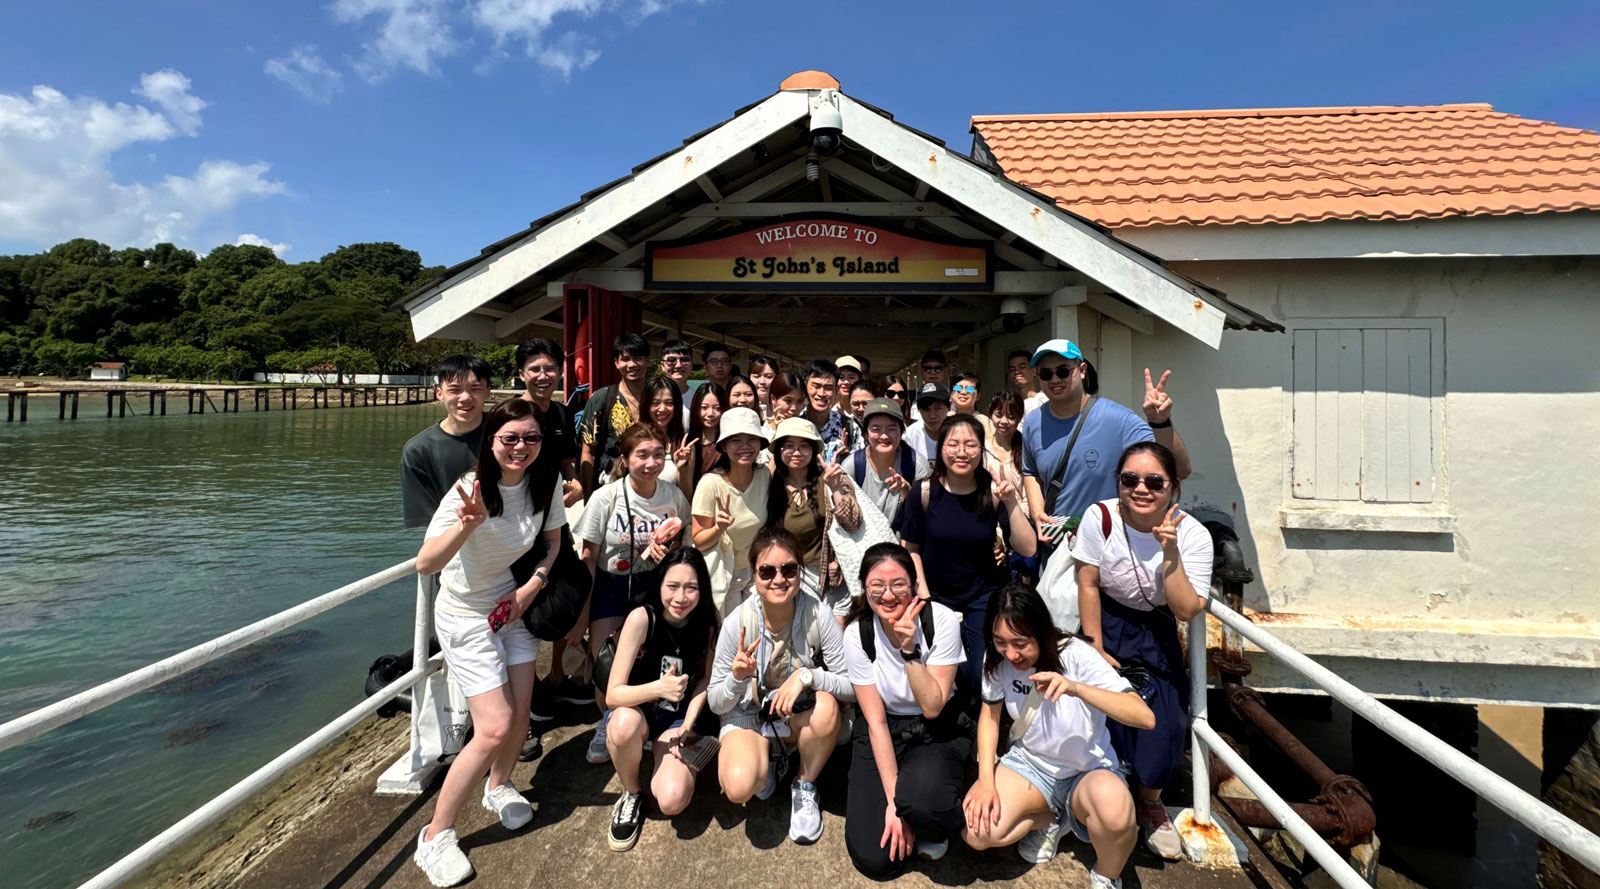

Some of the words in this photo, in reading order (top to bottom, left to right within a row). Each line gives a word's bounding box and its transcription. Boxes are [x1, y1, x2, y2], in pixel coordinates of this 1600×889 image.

[756, 223, 848, 245] WELCOME
[854, 228, 878, 245] TO
[732, 257, 756, 277] St
[761, 257, 825, 278] John's
[832, 257, 899, 276] Island
[1012, 680, 1032, 695] Su
